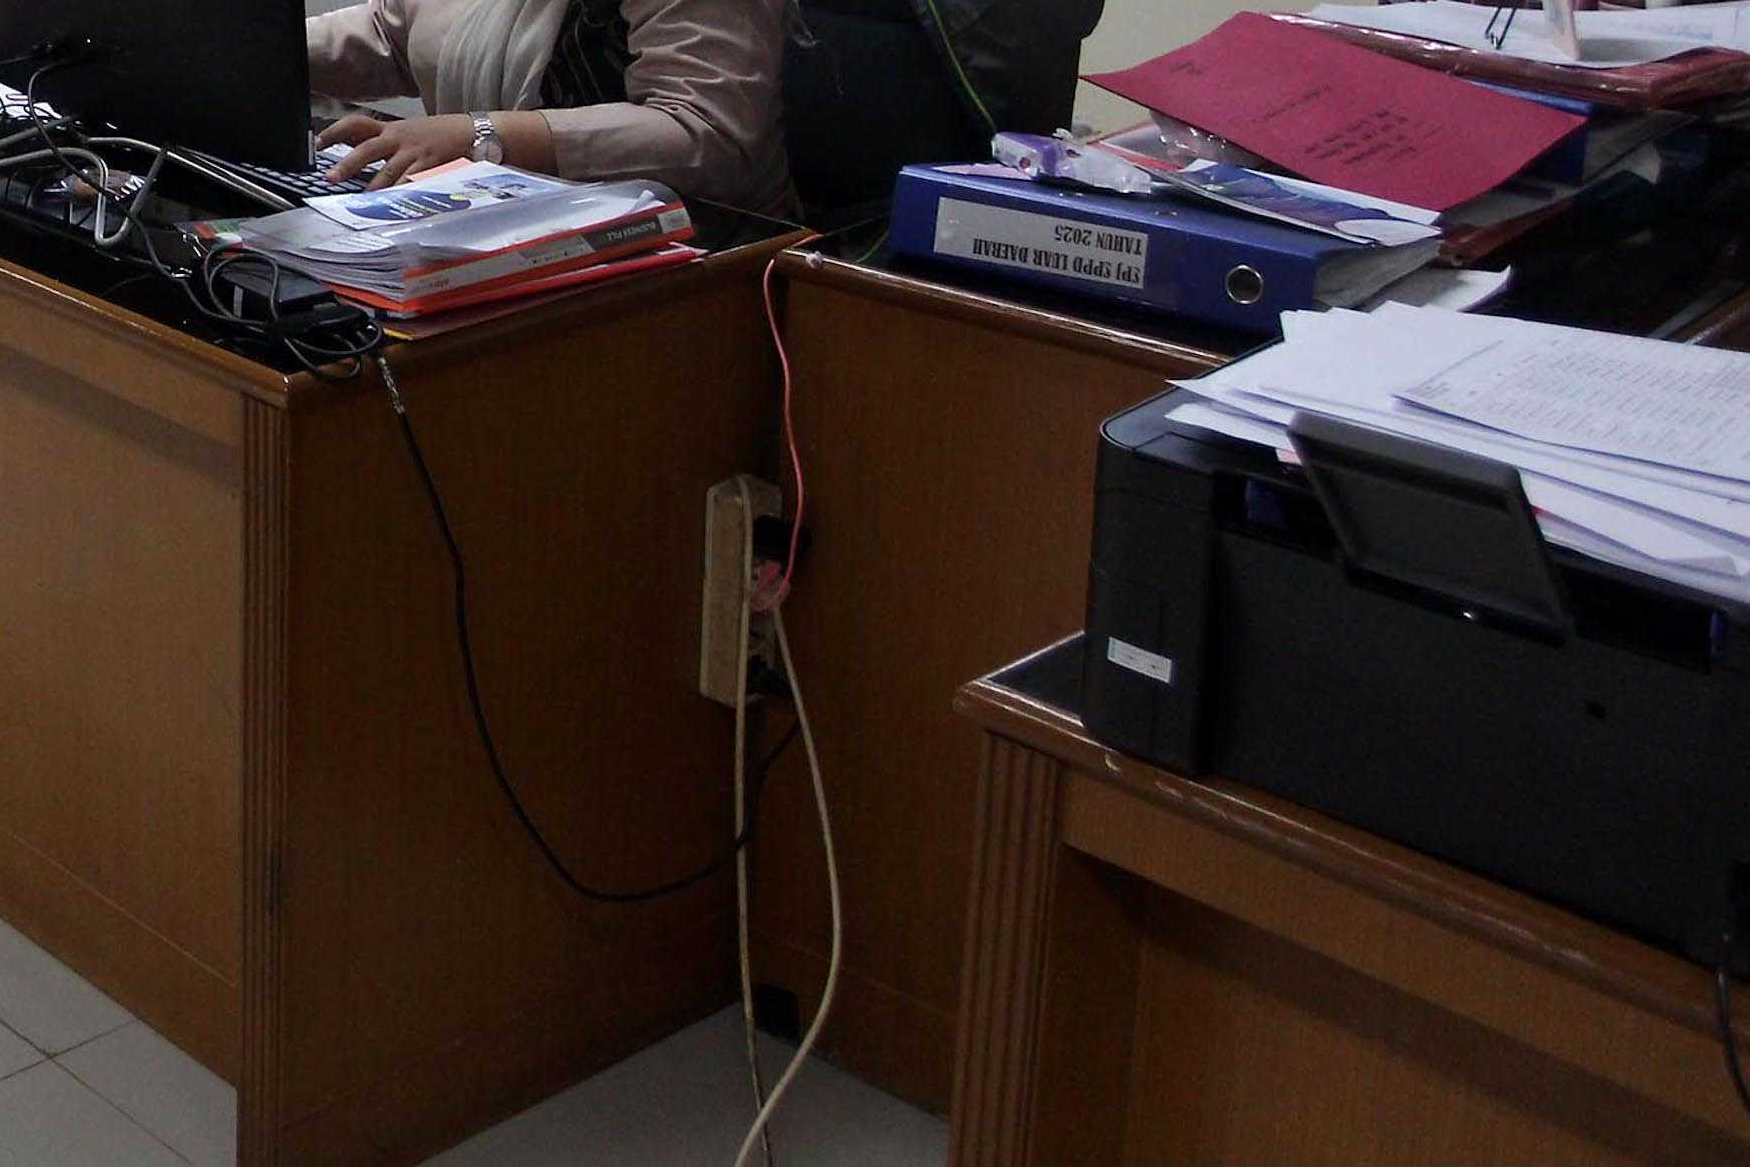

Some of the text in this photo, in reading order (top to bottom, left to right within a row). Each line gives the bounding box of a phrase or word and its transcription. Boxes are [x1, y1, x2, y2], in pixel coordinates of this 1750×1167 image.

[1054, 224, 1142, 255] TAHUN 2025
[972, 238, 1141, 284] SPJ SPPD LUAR DAERAH
